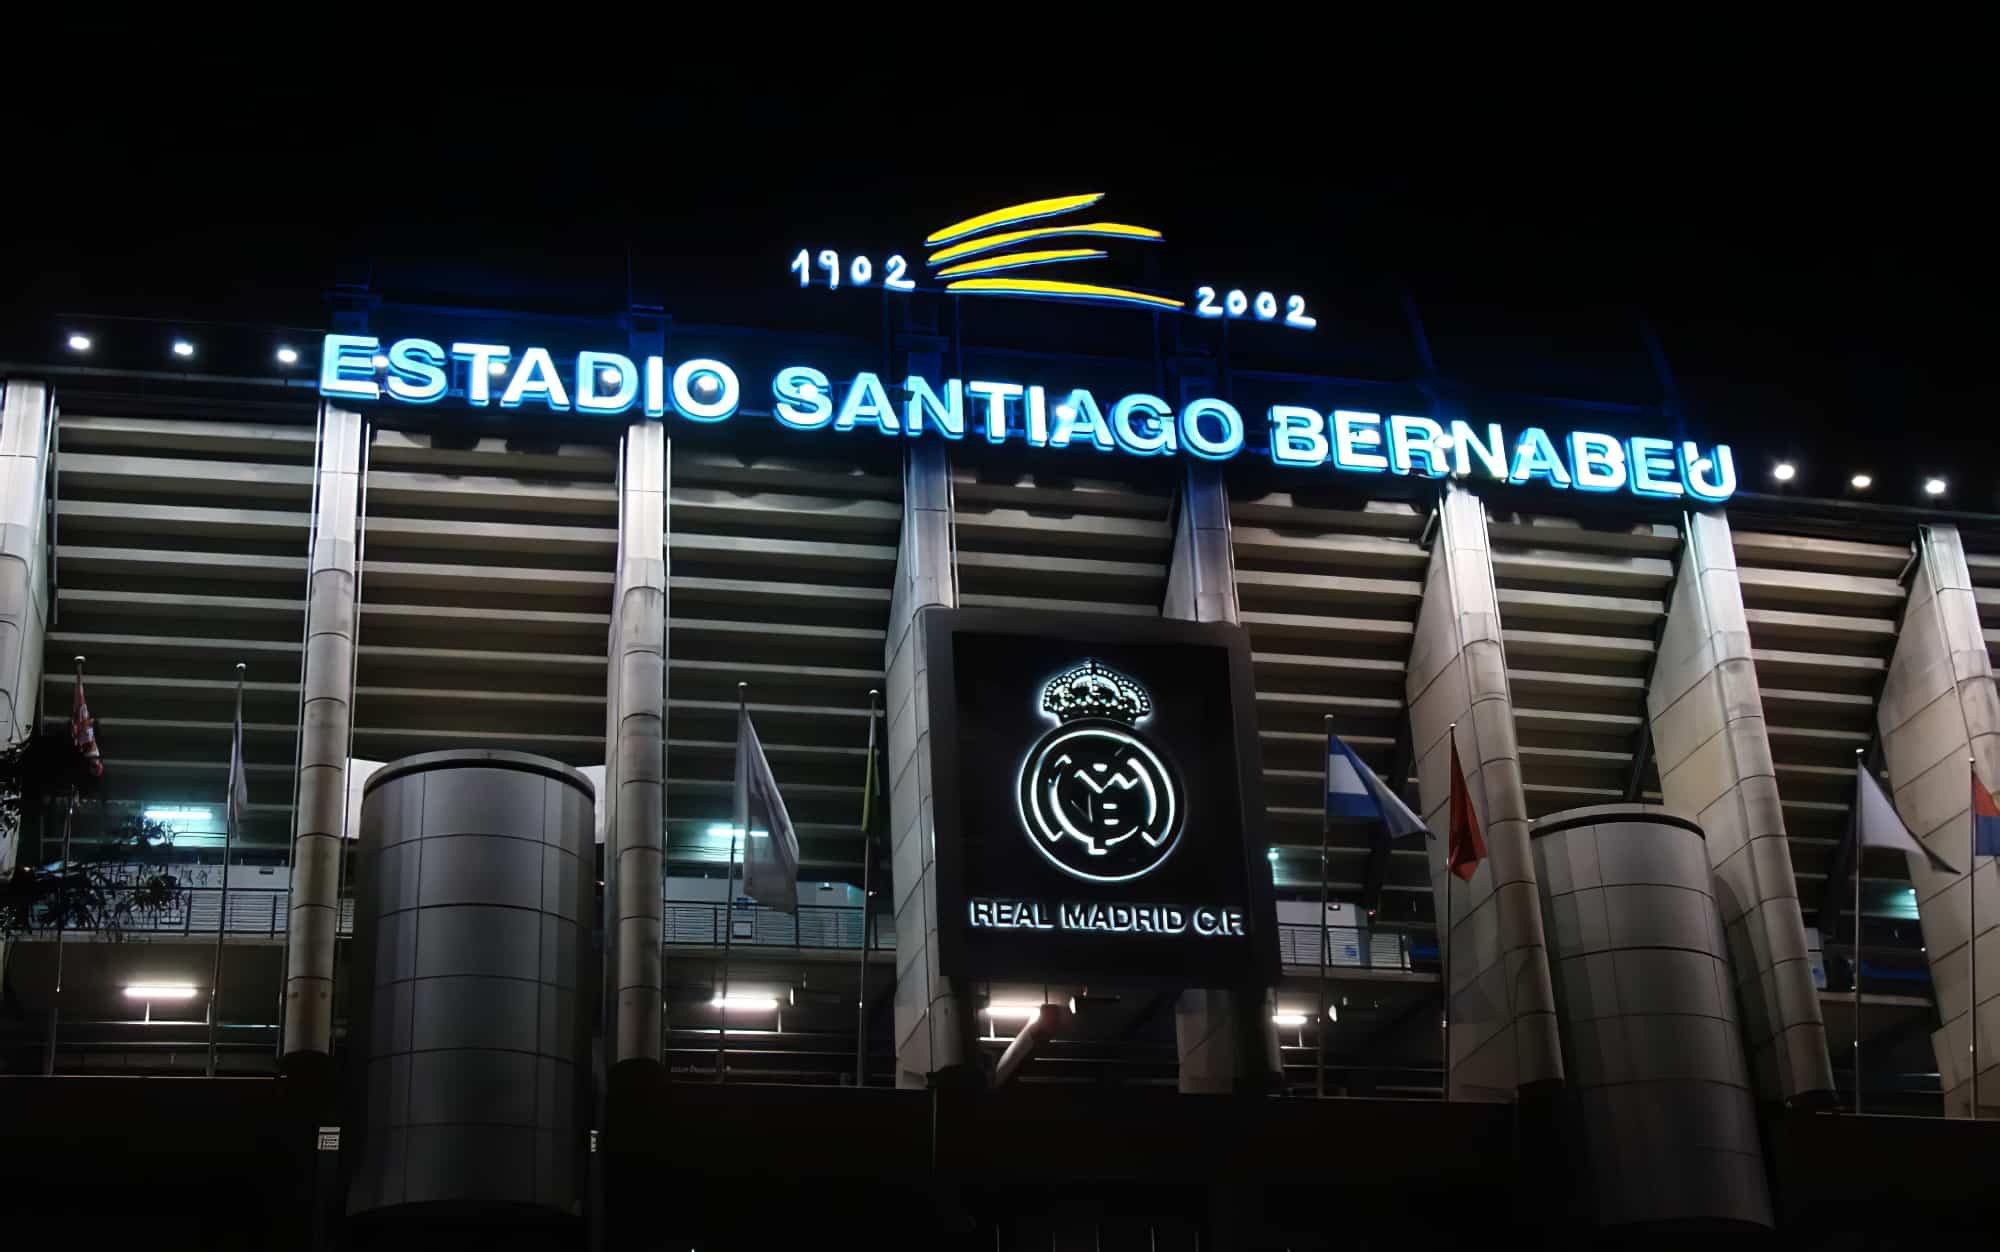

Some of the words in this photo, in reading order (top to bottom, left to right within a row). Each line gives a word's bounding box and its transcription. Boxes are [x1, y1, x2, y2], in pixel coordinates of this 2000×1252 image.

[791, 249, 915, 290] 1902
[1196, 286, 1316, 328] 2002
[319, 333, 739, 421] ESTADIO
[772, 365, 1244, 460] SANTIAGO
[1268, 404, 1737, 501] BERNABEU
[969, 899, 1054, 928] REAL
[1060, 902, 1187, 934] MADRID
